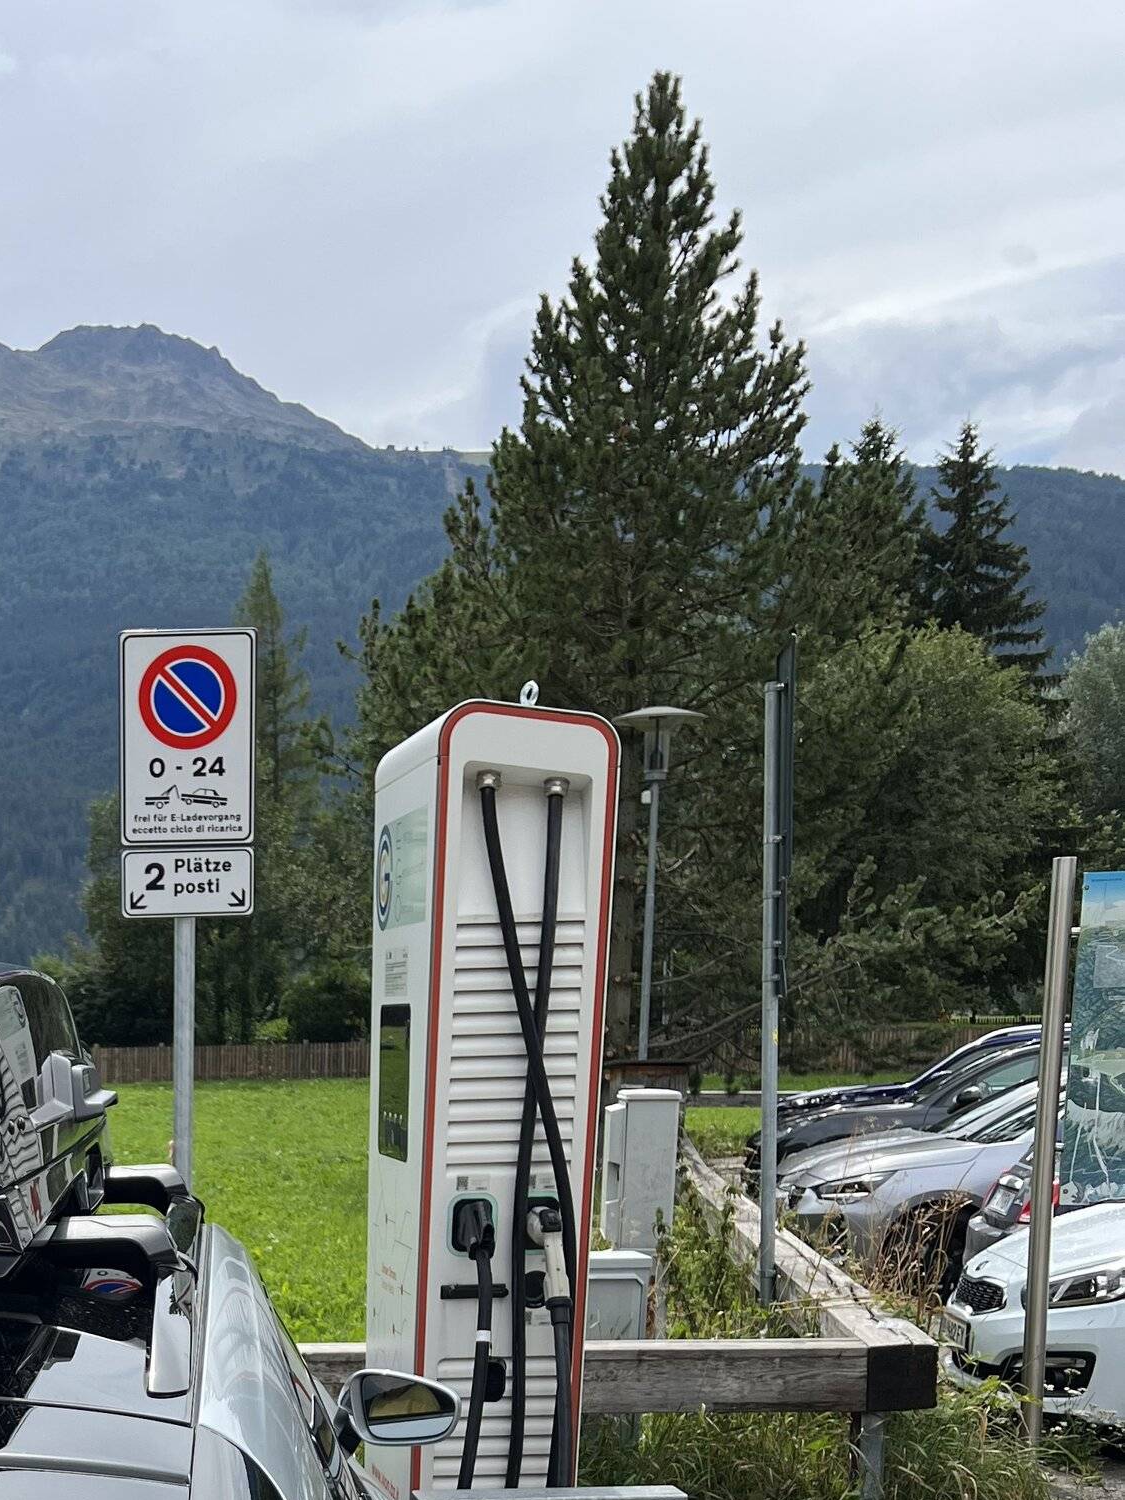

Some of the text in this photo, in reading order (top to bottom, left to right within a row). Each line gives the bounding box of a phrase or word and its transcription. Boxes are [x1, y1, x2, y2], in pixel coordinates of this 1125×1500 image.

[149, 757, 165, 778] 0
[192, 756, 226, 777] 24
[134, 813, 241, 822] frei für E-Ladevorgang
[132, 823, 243, 834] eccetto ciclo di ricarica
[174, 857, 232, 873] Plätze
[144, 862, 165, 891] 2
[174, 877, 220, 897] posti
